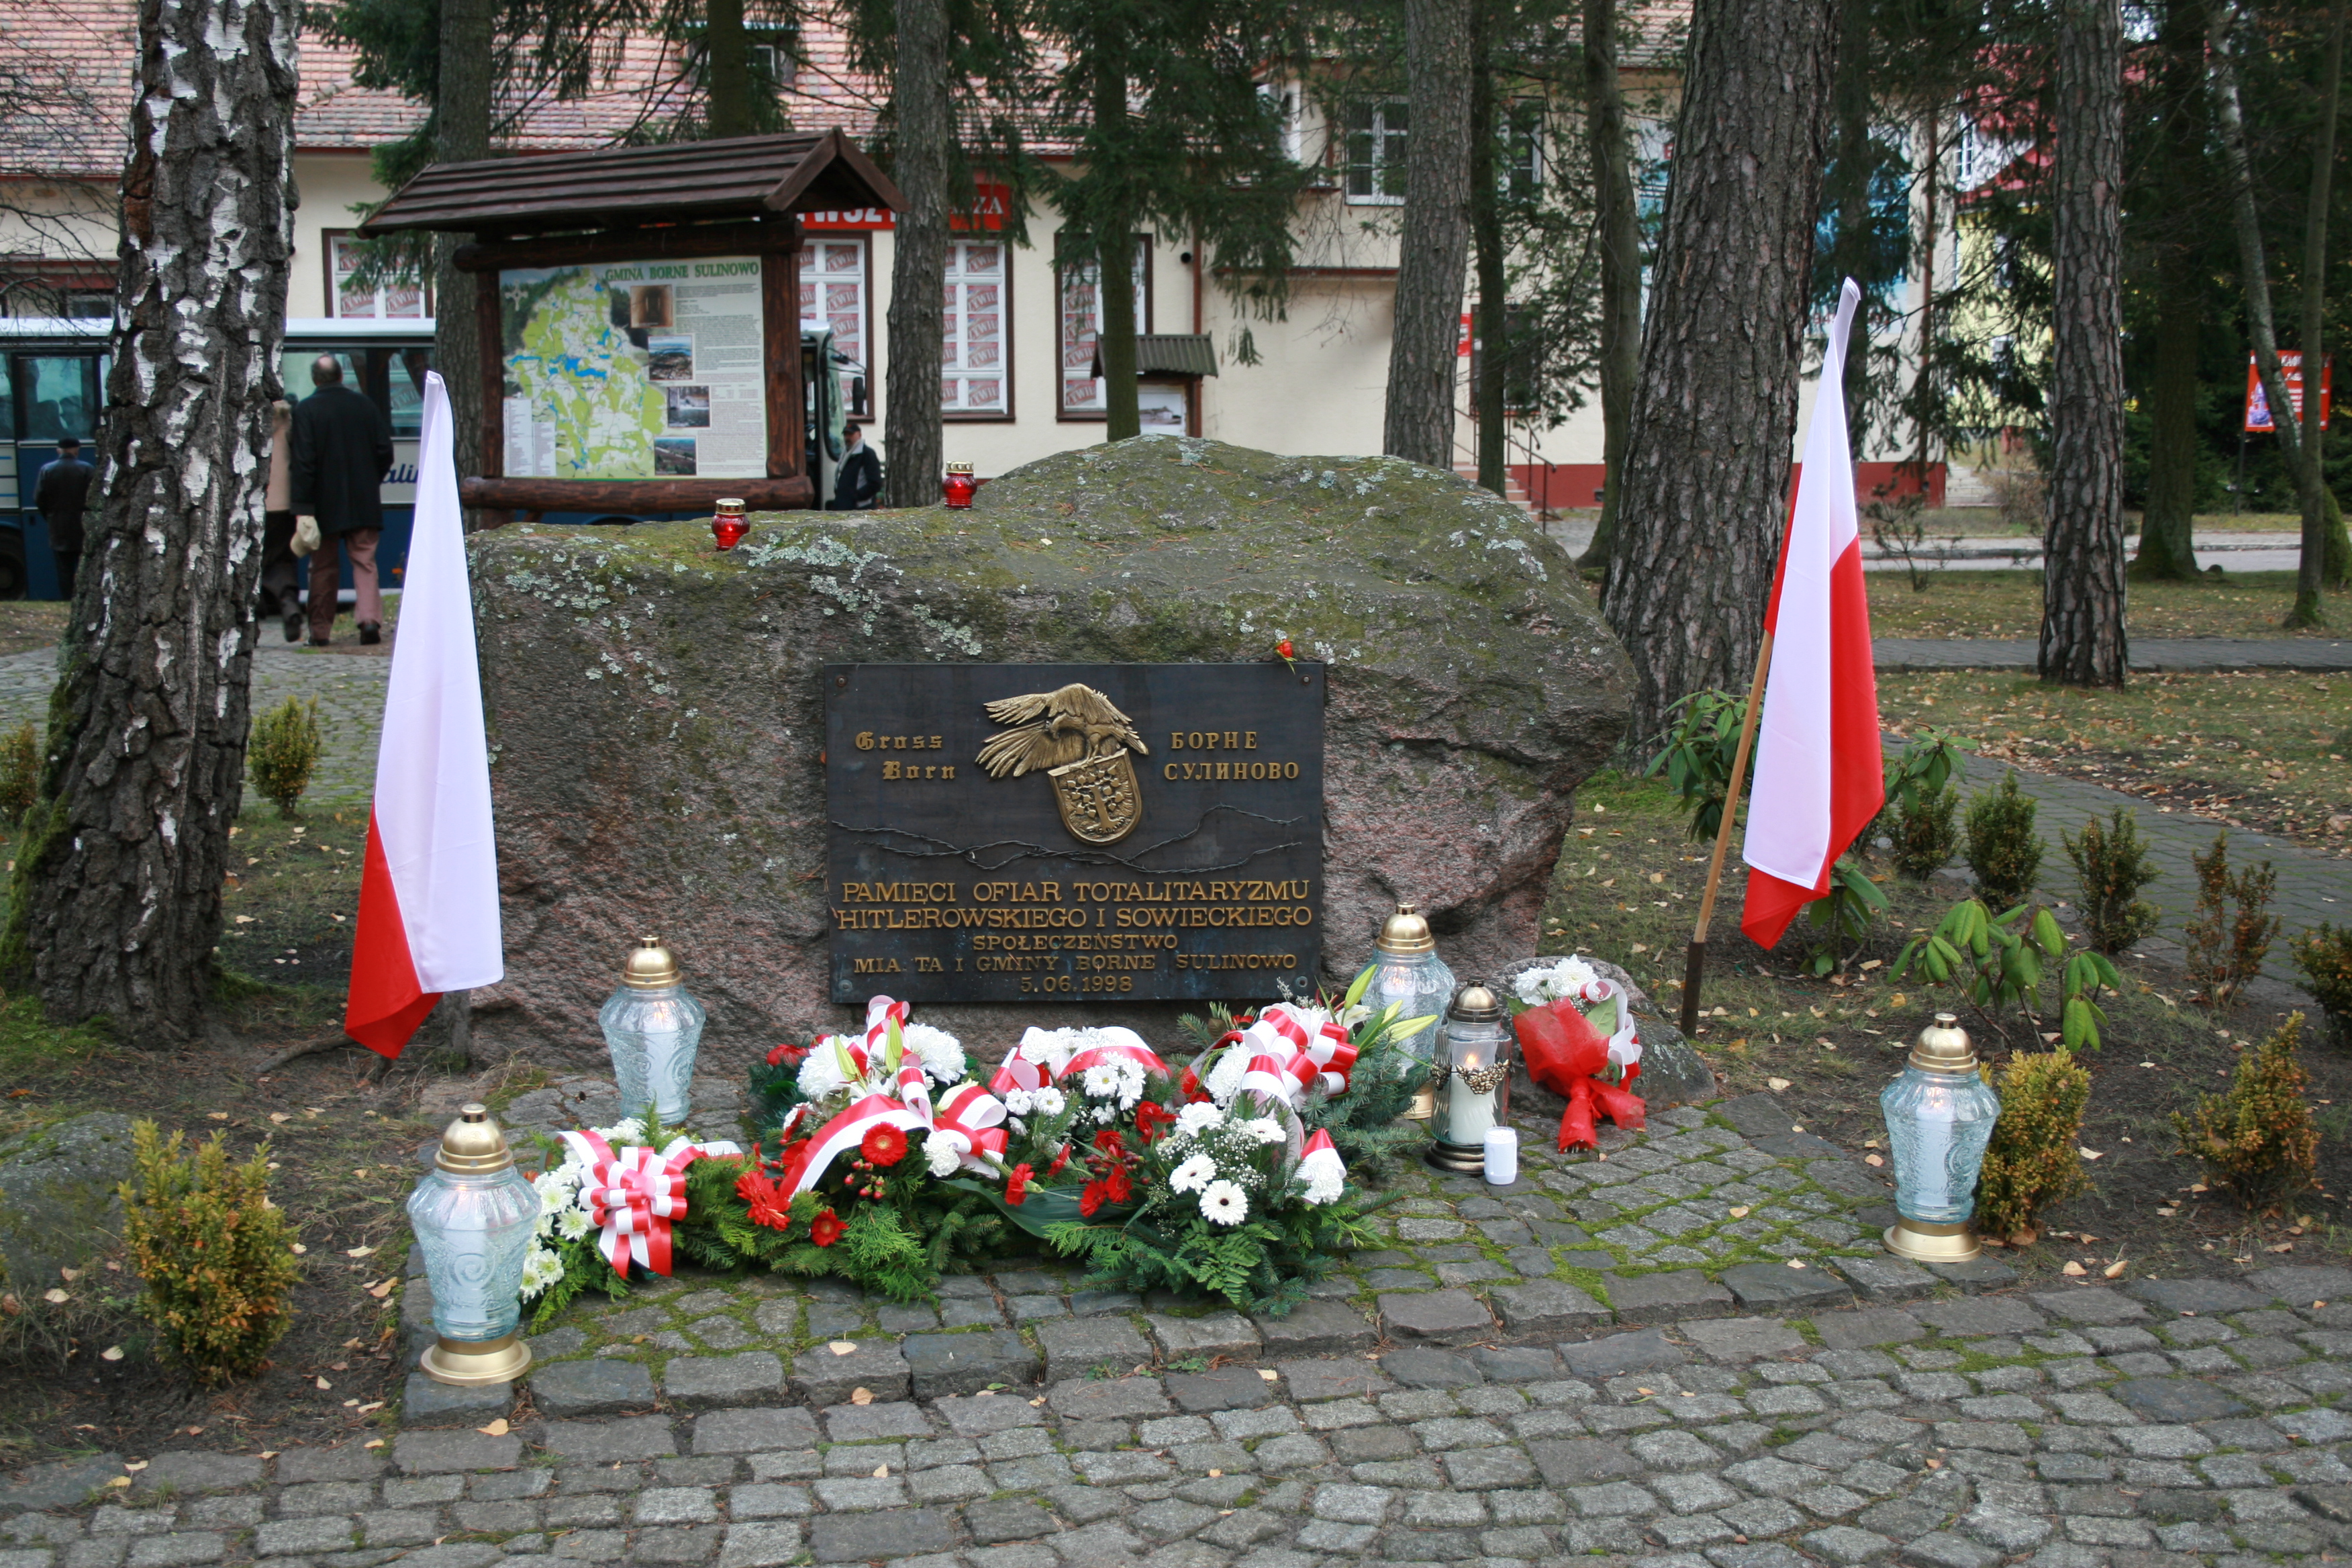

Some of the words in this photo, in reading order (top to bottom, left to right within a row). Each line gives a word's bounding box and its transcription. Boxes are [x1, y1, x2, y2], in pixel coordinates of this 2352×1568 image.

[605, 267, 644, 281] GMINA
[650, 264, 689, 279] BORNE
[695, 262, 759, 277] SULINOWO
[855, 731, 942, 750] Gross
[1171, 731, 1257, 749] БОРНЕ
[883, 761, 955, 780] Born
[1164, 762, 1300, 780] СУЛИНОВО
[842, 882, 957, 904] PAMIĘCI
[973, 881, 1062, 902] OFIAR
[1073, 880, 1310, 901] TOTALITARYZMU
[838, 908, 1087, 930] HITLEROWSKIEGO
[1096, 908, 1106, 928] I
[1117, 906, 1312, 928] SOWIECKIEGO
[955, 958, 963, 972] I
[976, 956, 1059, 971] GMINY
[1076, 954, 1156, 971] BORNE
[1176, 953, 1297, 970] SULINOWO
[1020, 975, 1133, 993] 5.06.1998
